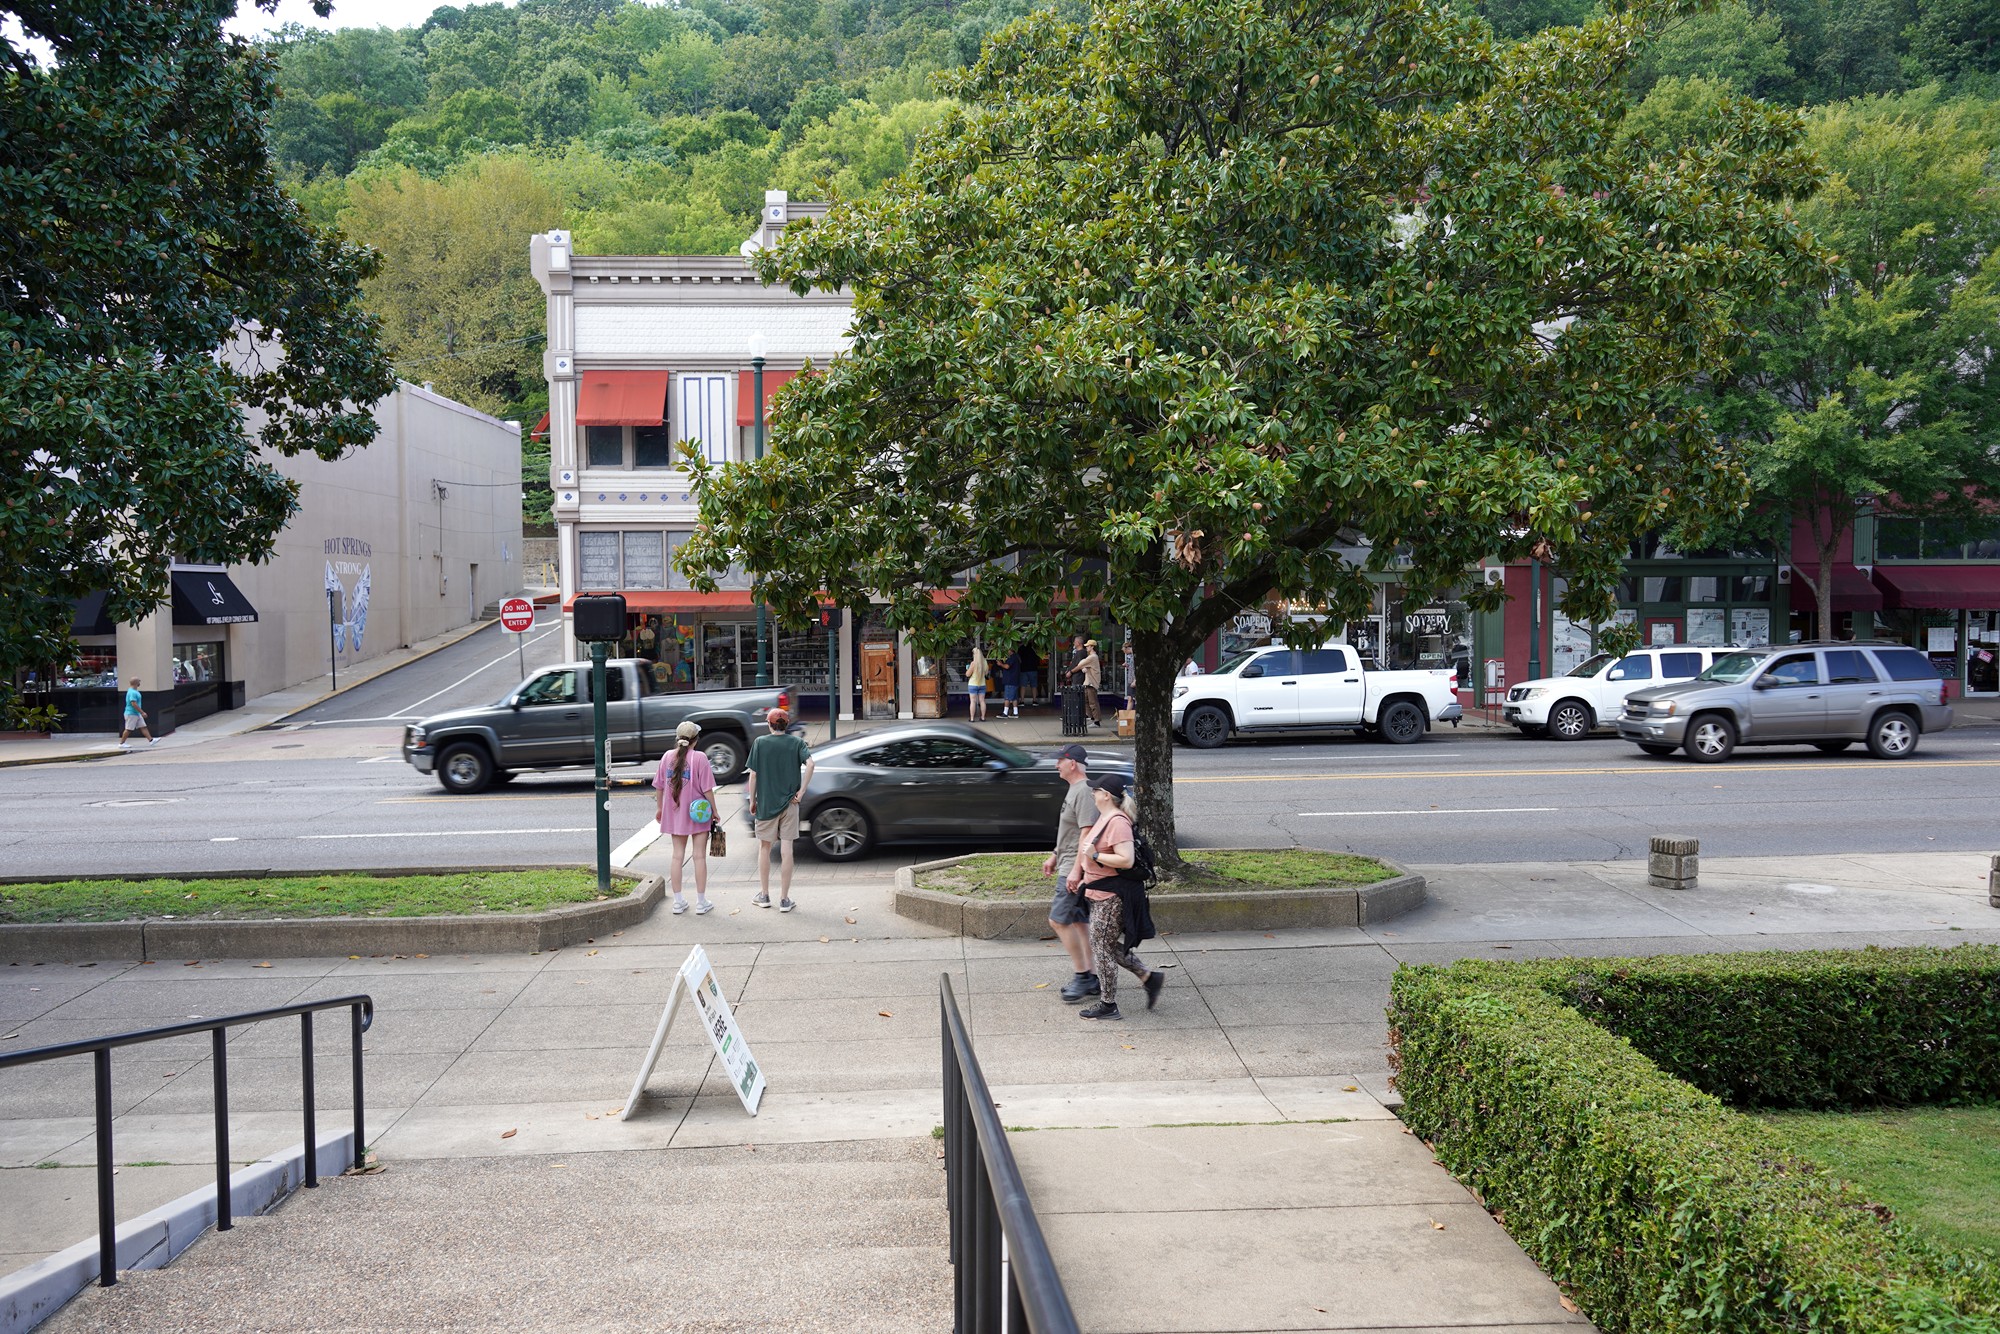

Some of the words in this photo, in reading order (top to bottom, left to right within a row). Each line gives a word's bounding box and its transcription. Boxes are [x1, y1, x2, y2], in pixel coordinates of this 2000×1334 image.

[324, 538, 340, 554] HOT
[342, 537, 371, 557] SPRINGS
[584, 537, 616, 546] ESTATES
[335, 561, 362, 575] STRONG
[585, 558, 614, 567] SOLD
[583, 572, 619, 581] BROKERS
[1233, 615, 1274, 635] SOAPERY
